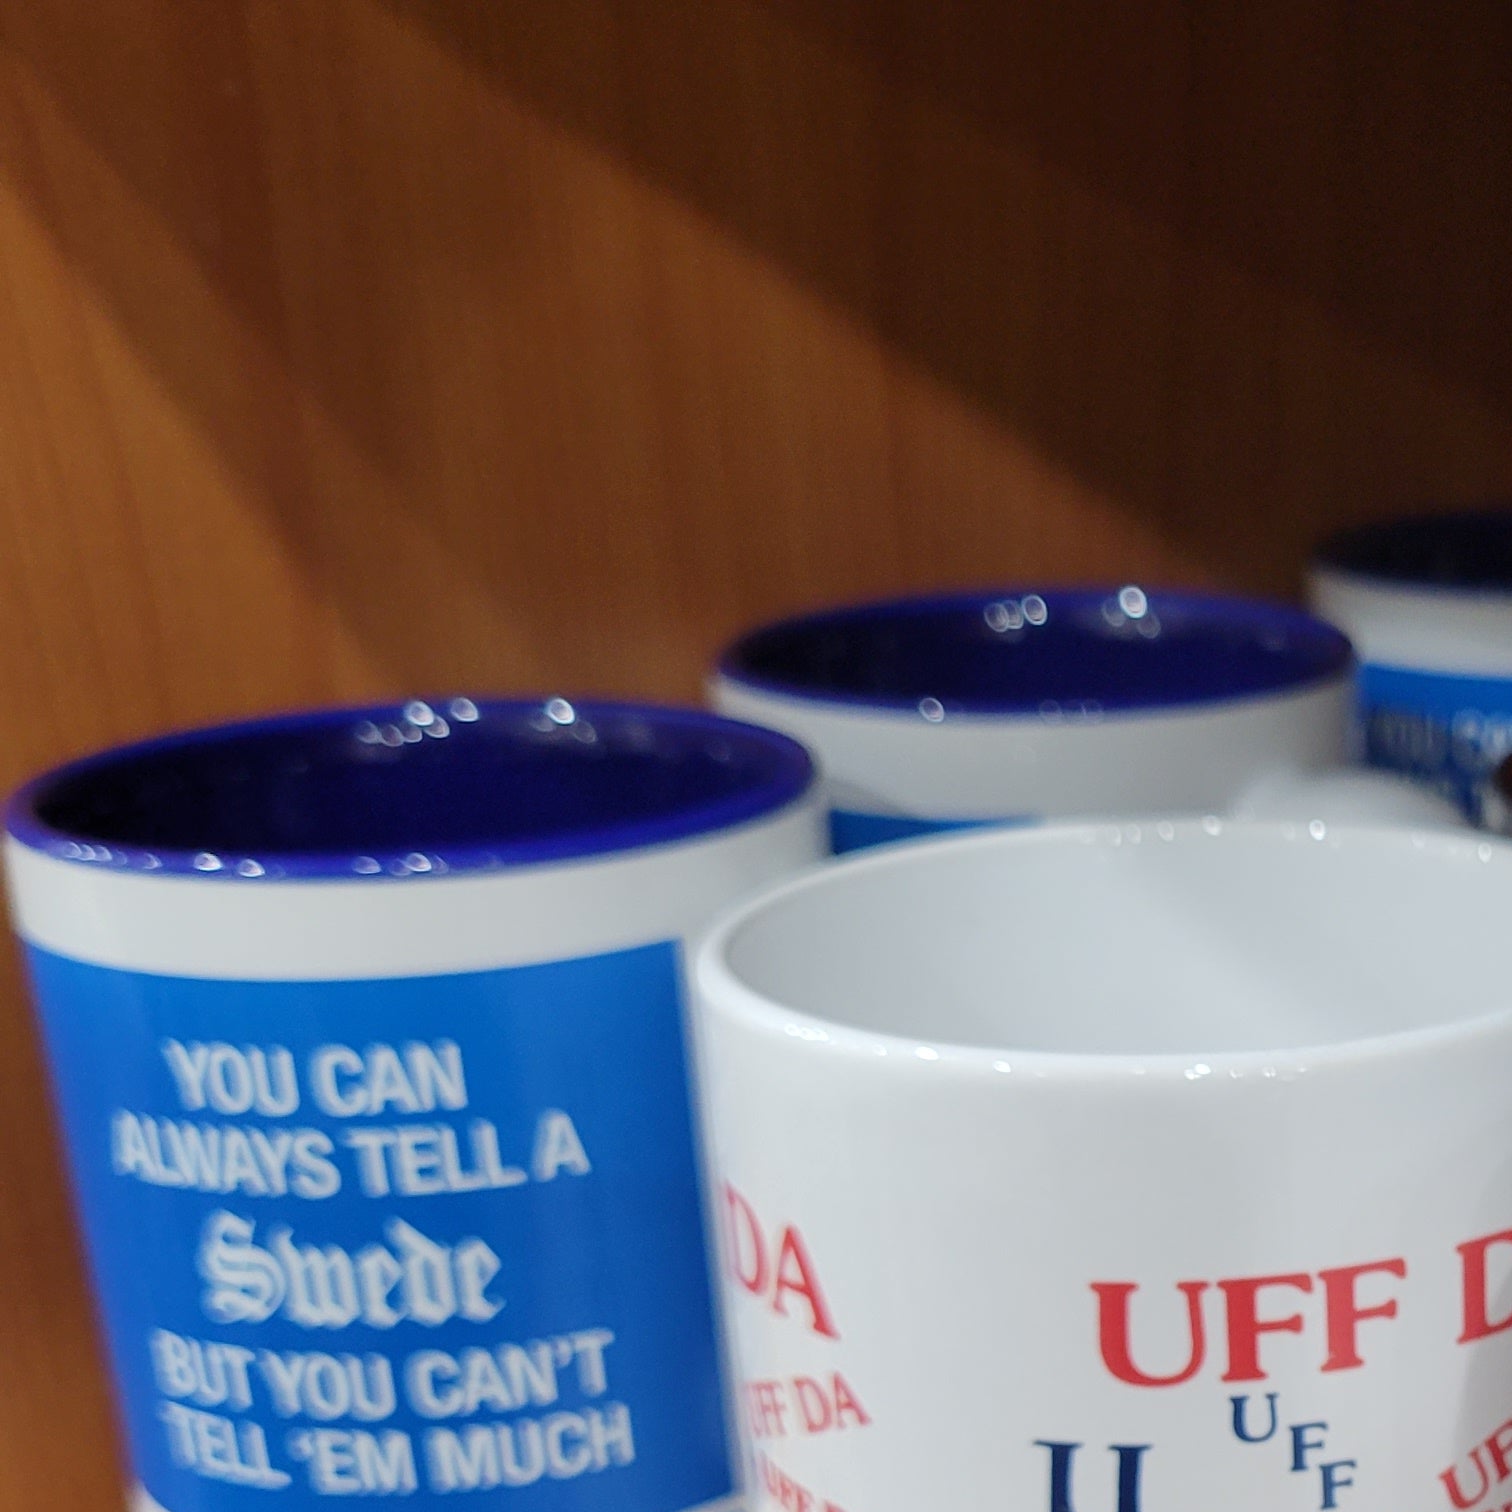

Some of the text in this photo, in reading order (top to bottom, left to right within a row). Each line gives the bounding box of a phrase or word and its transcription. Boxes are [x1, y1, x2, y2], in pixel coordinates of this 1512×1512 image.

[162, 1038, 468, 1118] YOU CAN
[112, 1108, 591, 1199] ALWAYS TELL A
[203, 1208, 503, 1329] Swede
[724, 1181, 841, 1340] DA
[1088, 1257, 1408, 1388] UFF
[152, 1328, 615, 1421] BUT YOU CAN'T
[795, 1371, 872, 1434] DA
[157, 1402, 636, 1496] TELL 'EM MUCH
[1229, 1392, 1357, 1511] UFF
